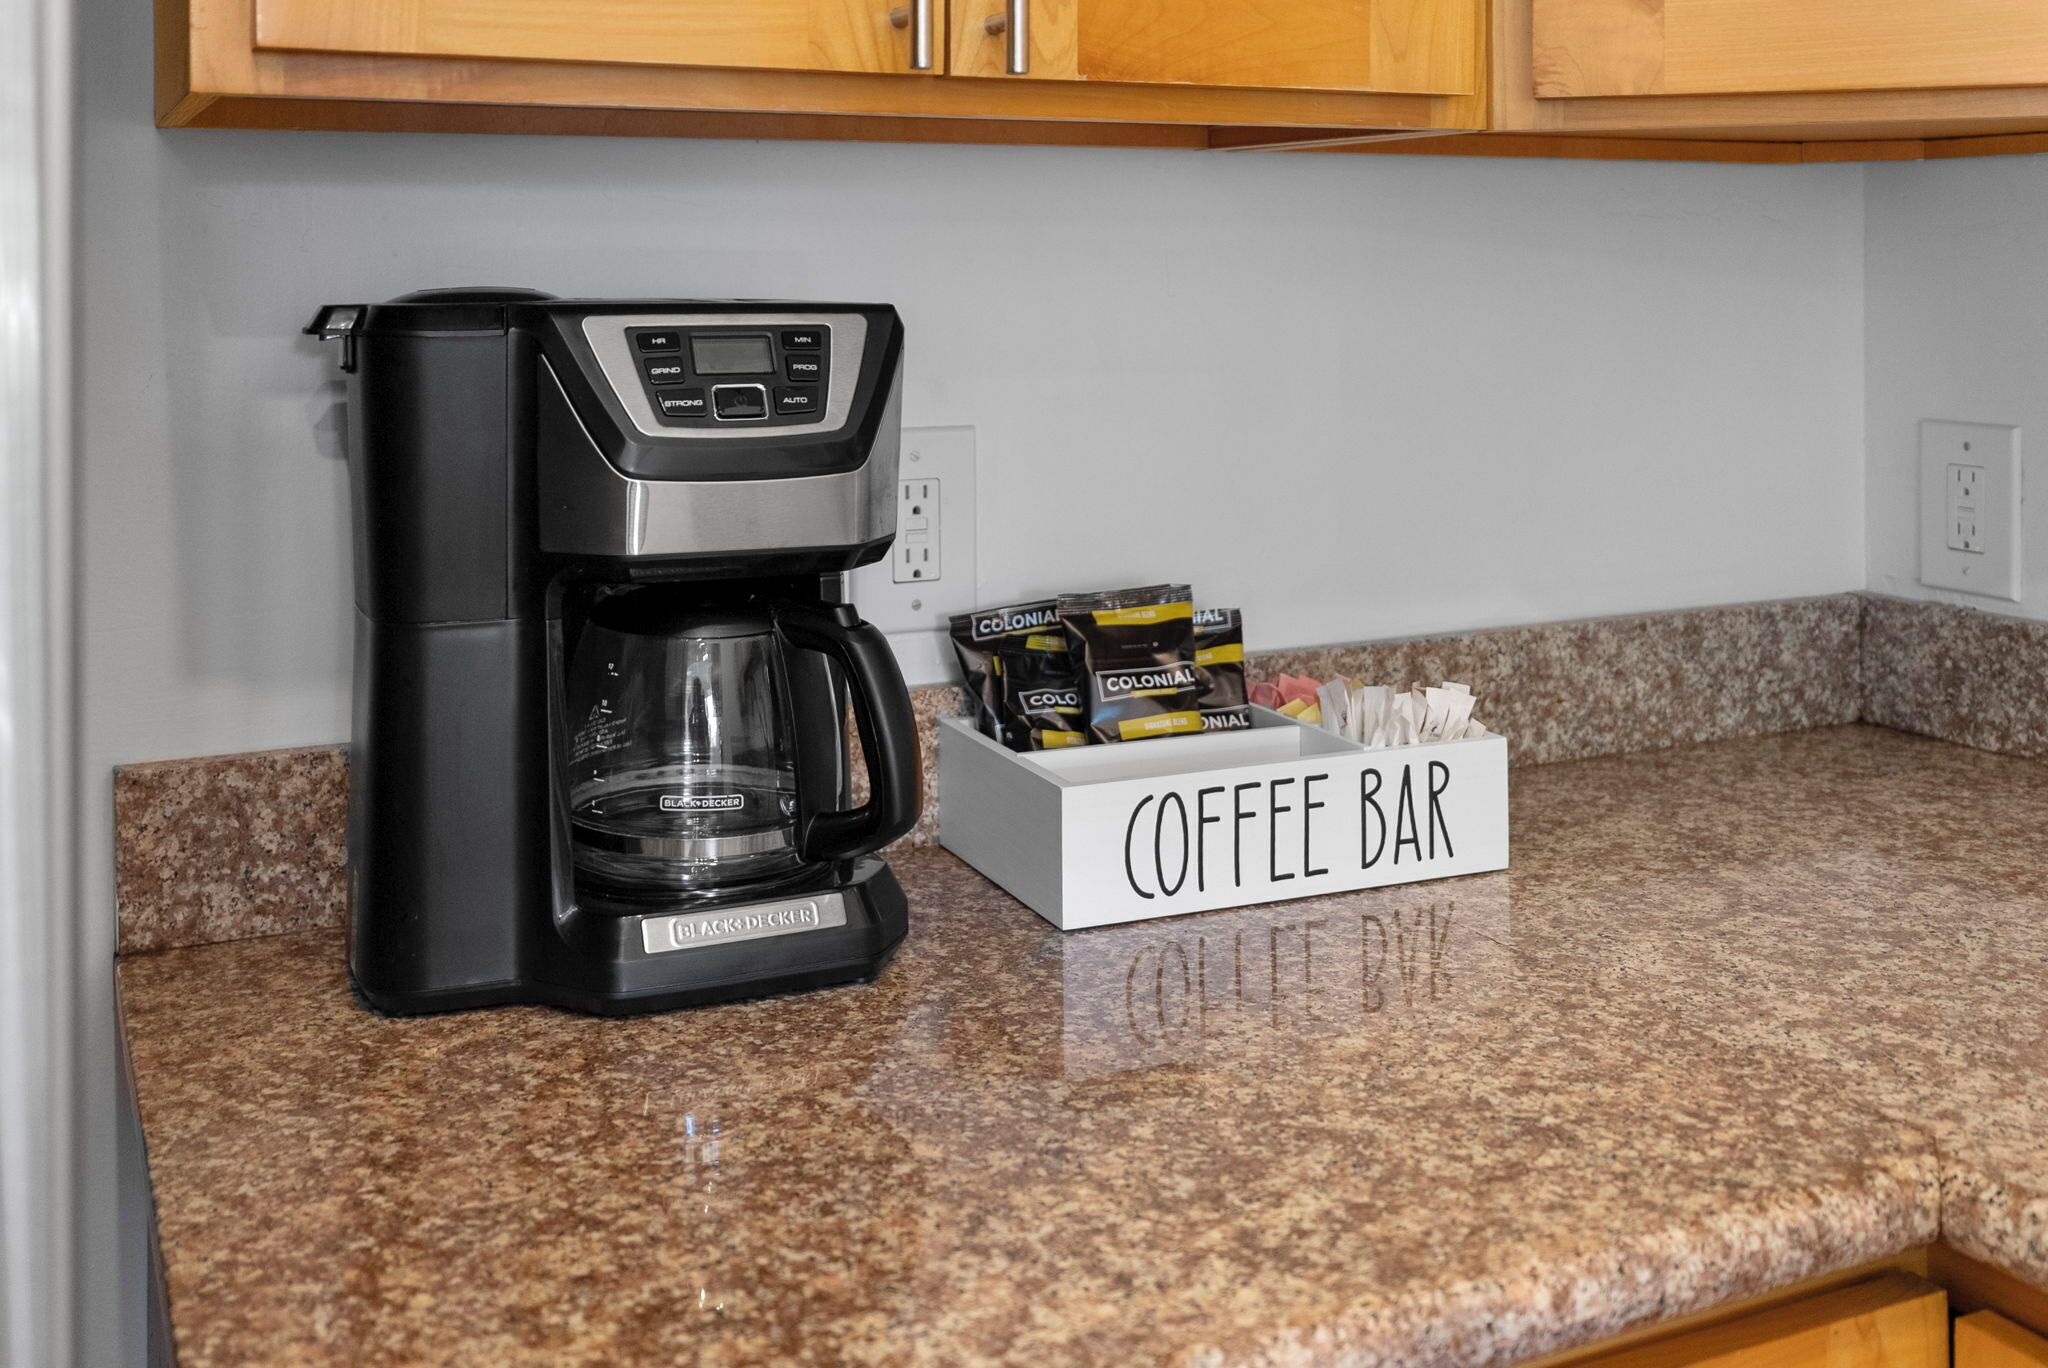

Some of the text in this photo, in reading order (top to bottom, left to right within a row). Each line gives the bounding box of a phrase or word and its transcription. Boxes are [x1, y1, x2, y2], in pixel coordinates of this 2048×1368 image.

[652, 337, 666, 345] HR
[794, 335, 812, 343] MIN
[651, 366, 681, 375] GRIND
[793, 363, 818, 371] PROG
[664, 399, 703, 408] STRONG
[783, 396, 808, 404] AUTO
[1106, 668, 1196, 692] COLONIAL
[1124, 760, 1454, 900] COFFEE BAR
